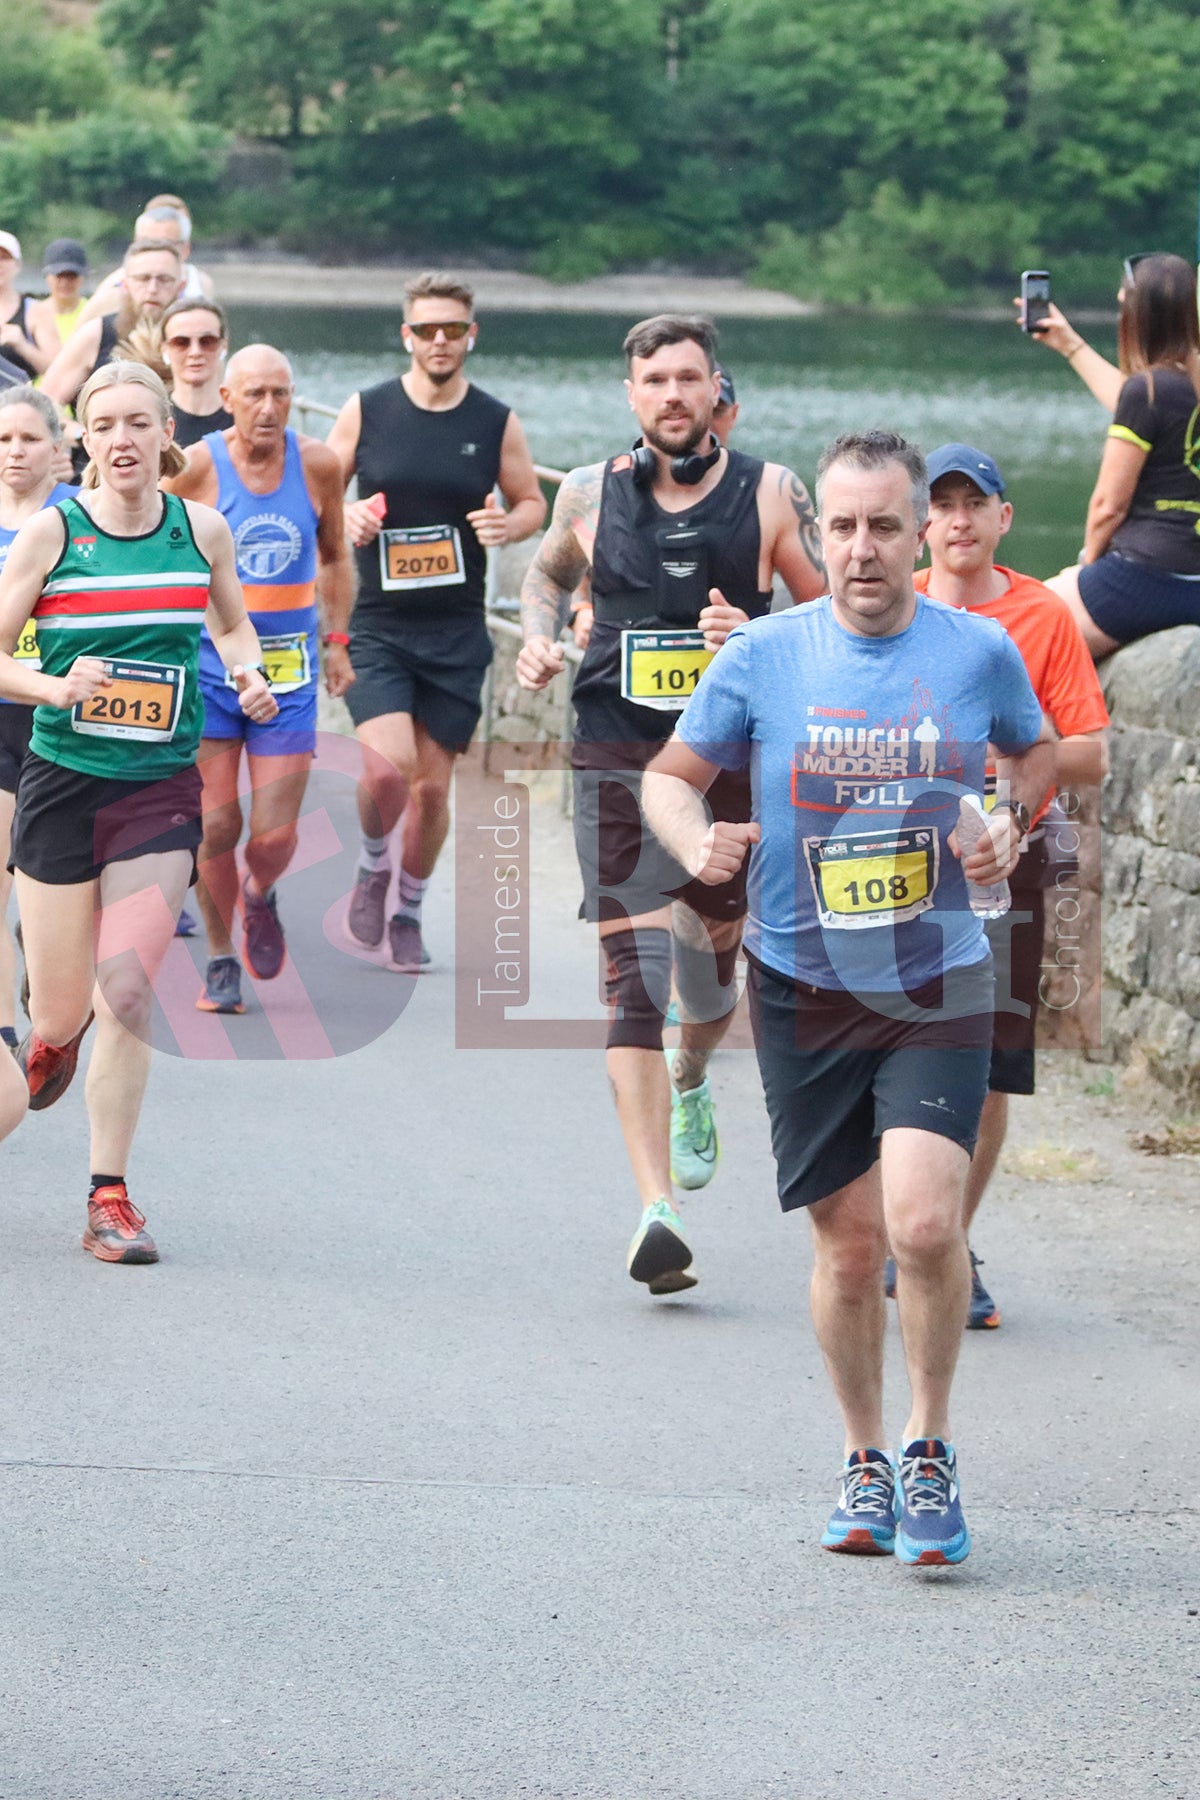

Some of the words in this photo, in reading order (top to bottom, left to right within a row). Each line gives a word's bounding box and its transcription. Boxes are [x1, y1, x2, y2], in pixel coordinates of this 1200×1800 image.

[396, 555, 449, 575] 2070
[90, 695, 162, 724] 2013
[806, 724, 910, 759] TOUGH
[803, 752, 909, 777] MUDDER
[834, 780, 914, 806] FULL
[844, 874, 909, 906] 108
